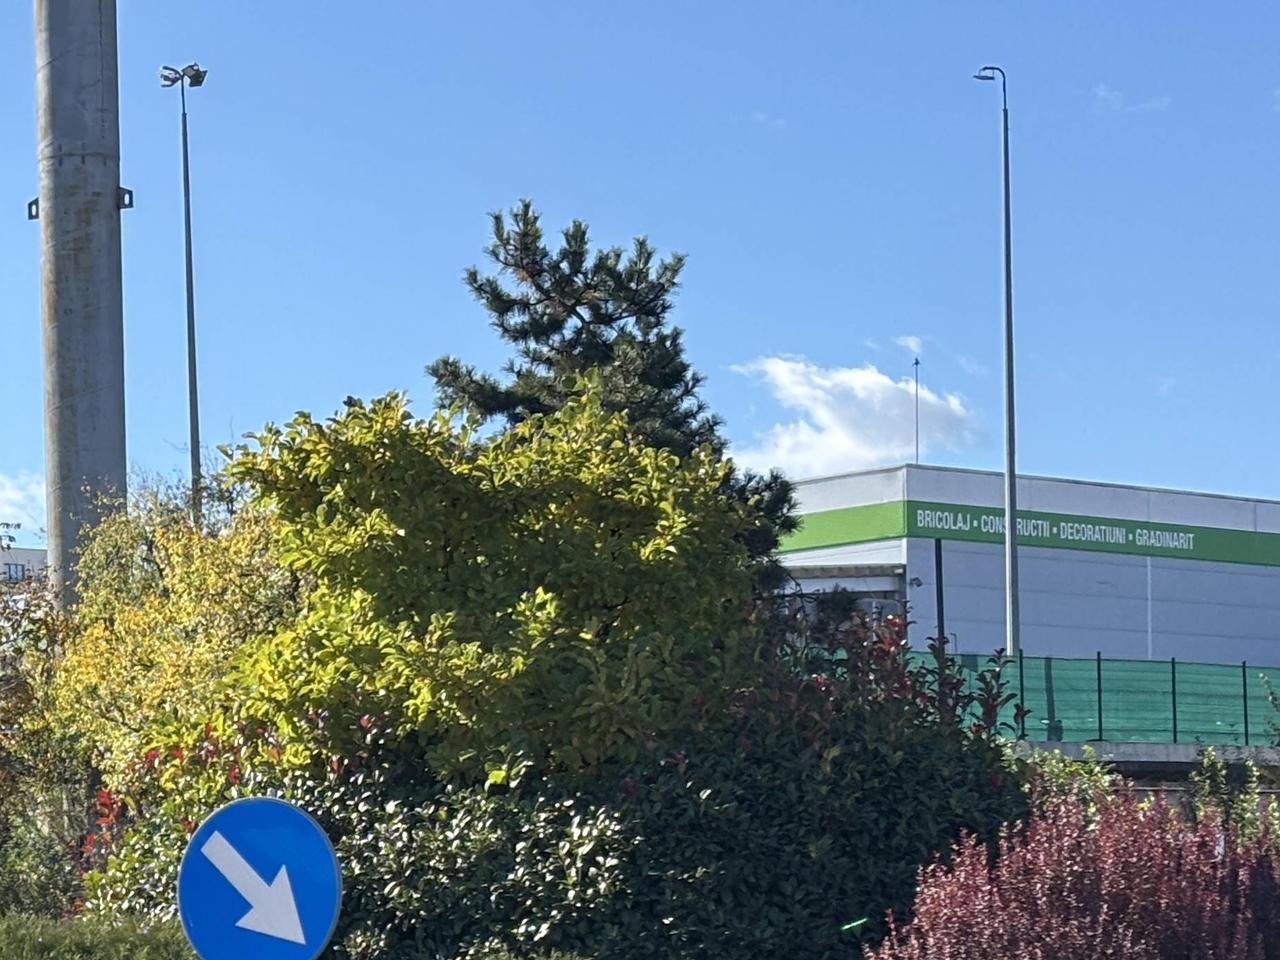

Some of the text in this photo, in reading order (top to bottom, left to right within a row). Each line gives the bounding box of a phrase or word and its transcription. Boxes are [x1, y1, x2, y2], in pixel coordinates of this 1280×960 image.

[916, 510, 1195, 550] BRICOLAJ CONSRUCTII DECORATIUNI GRADINARIT
